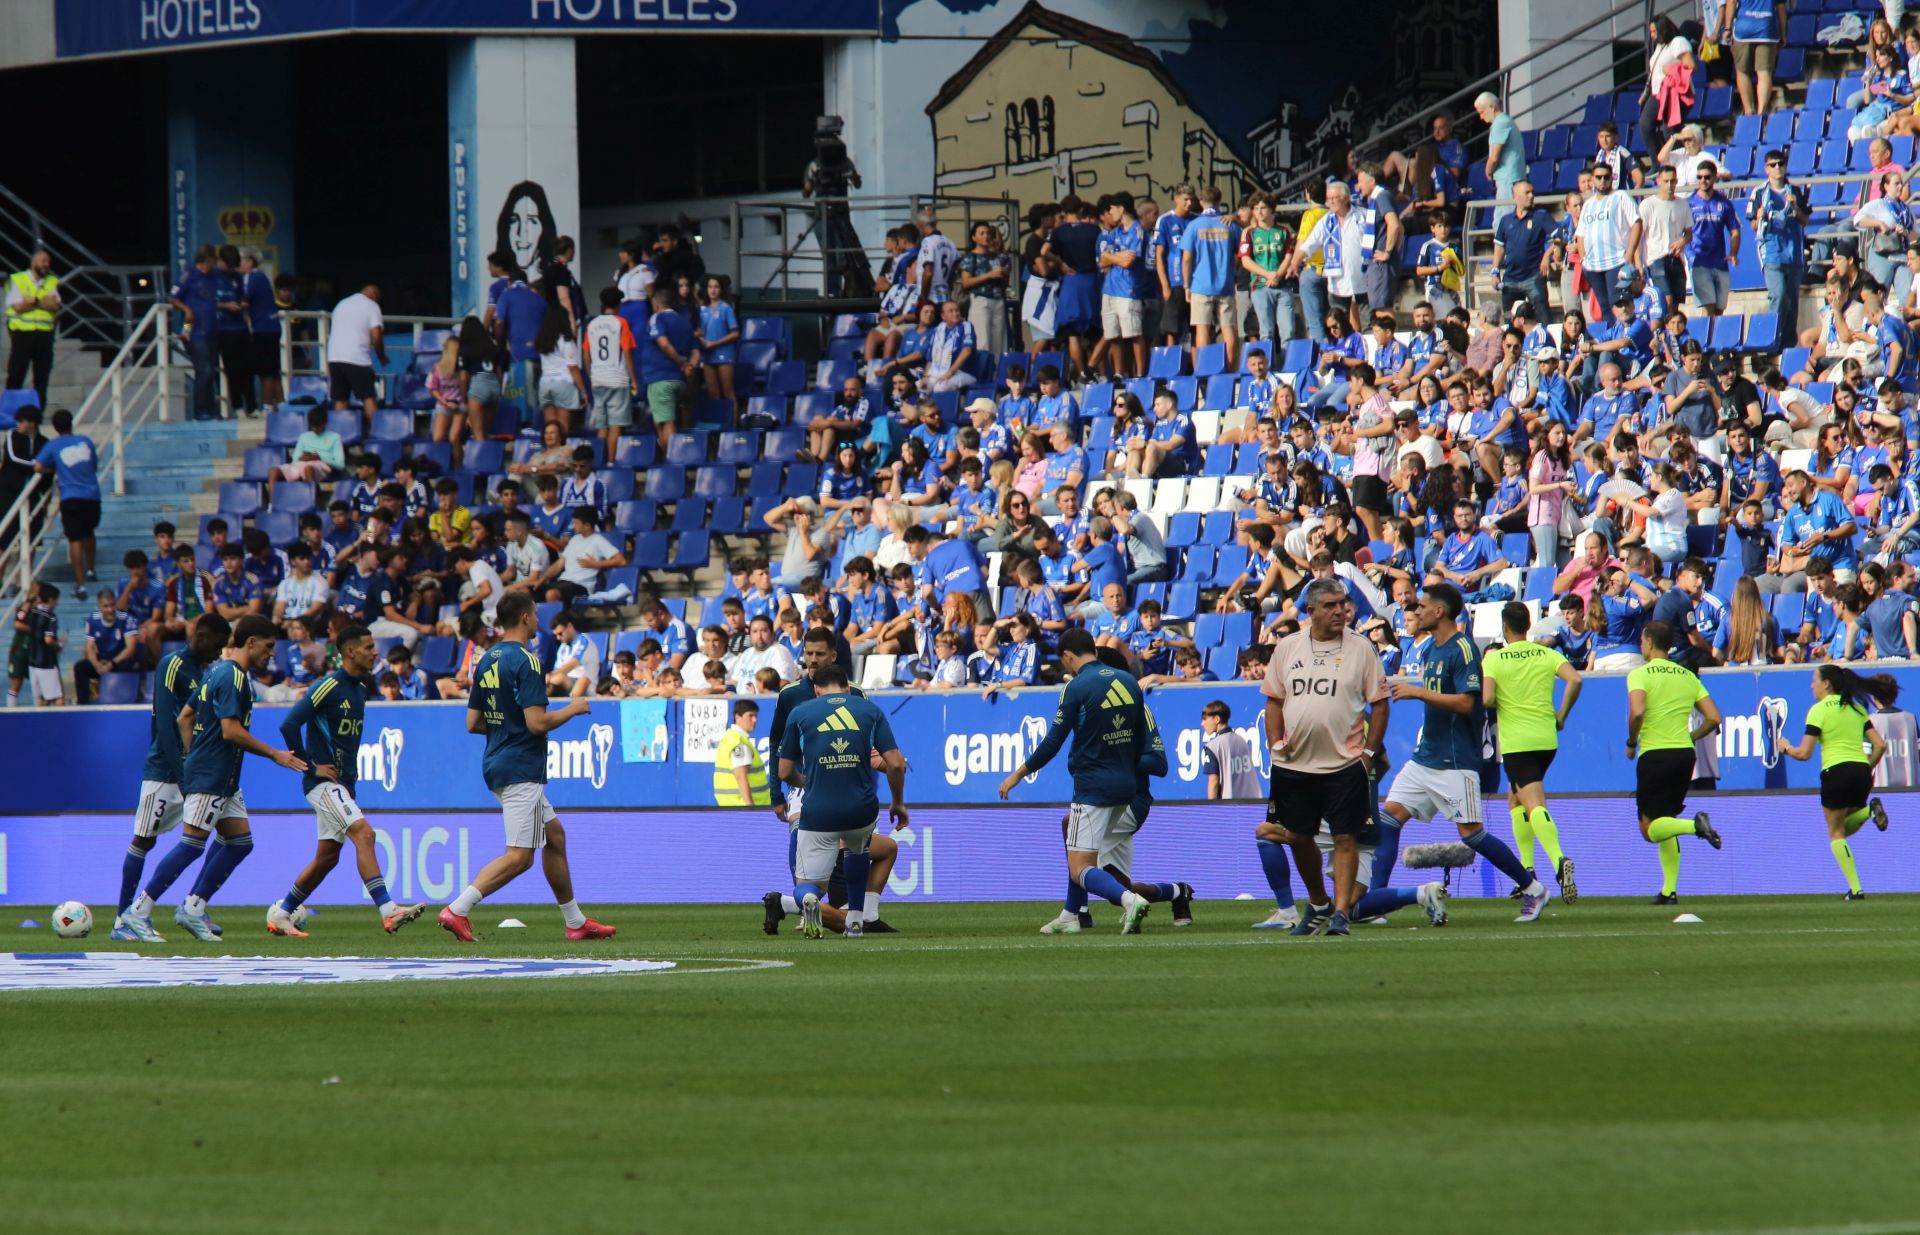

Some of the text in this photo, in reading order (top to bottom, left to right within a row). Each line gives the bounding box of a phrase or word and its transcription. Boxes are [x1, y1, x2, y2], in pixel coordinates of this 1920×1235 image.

[141, 0, 261, 40] HOTELES
[455, 143, 467, 279] PUESTO
[1586, 210, 1610, 225] DIGI
[175, 170, 187, 273] PUEST
[598, 335, 609, 361] 8
[1500, 649, 1546, 660] macron
[1292, 679, 1338, 697] DIGI
[1424, 677, 1442, 694] IGI
[338, 719, 363, 736] DI
[547, 739, 592, 780] am
[818, 754, 861, 764] CAJA RURAL
[944, 732, 1024, 786] gam
[332, 787, 345, 803] 7
[154, 799, 167, 818] 3
[887, 826, 934, 897] GI
